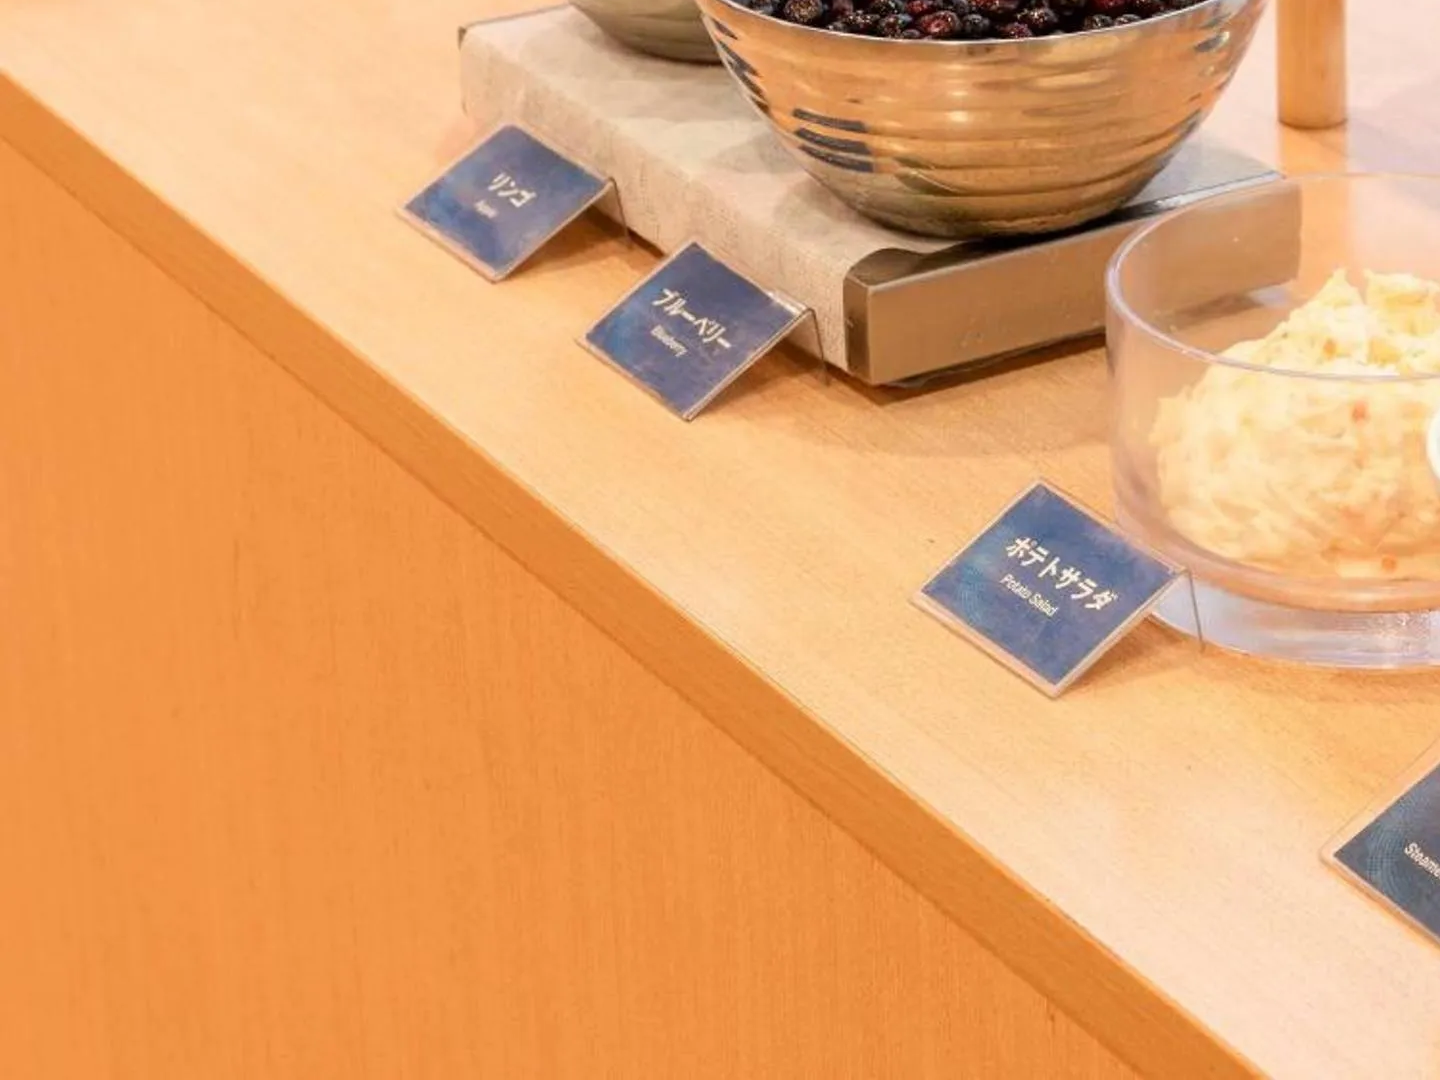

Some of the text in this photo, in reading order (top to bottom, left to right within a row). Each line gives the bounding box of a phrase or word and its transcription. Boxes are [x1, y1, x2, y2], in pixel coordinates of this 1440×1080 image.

[488, 172, 537, 208] リンゴ
[652, 288, 732, 349] ブルーベリー
[1000, 573, 1059, 617] Potato Salad
[1006, 536, 1118, 610] ポテトサラダ
